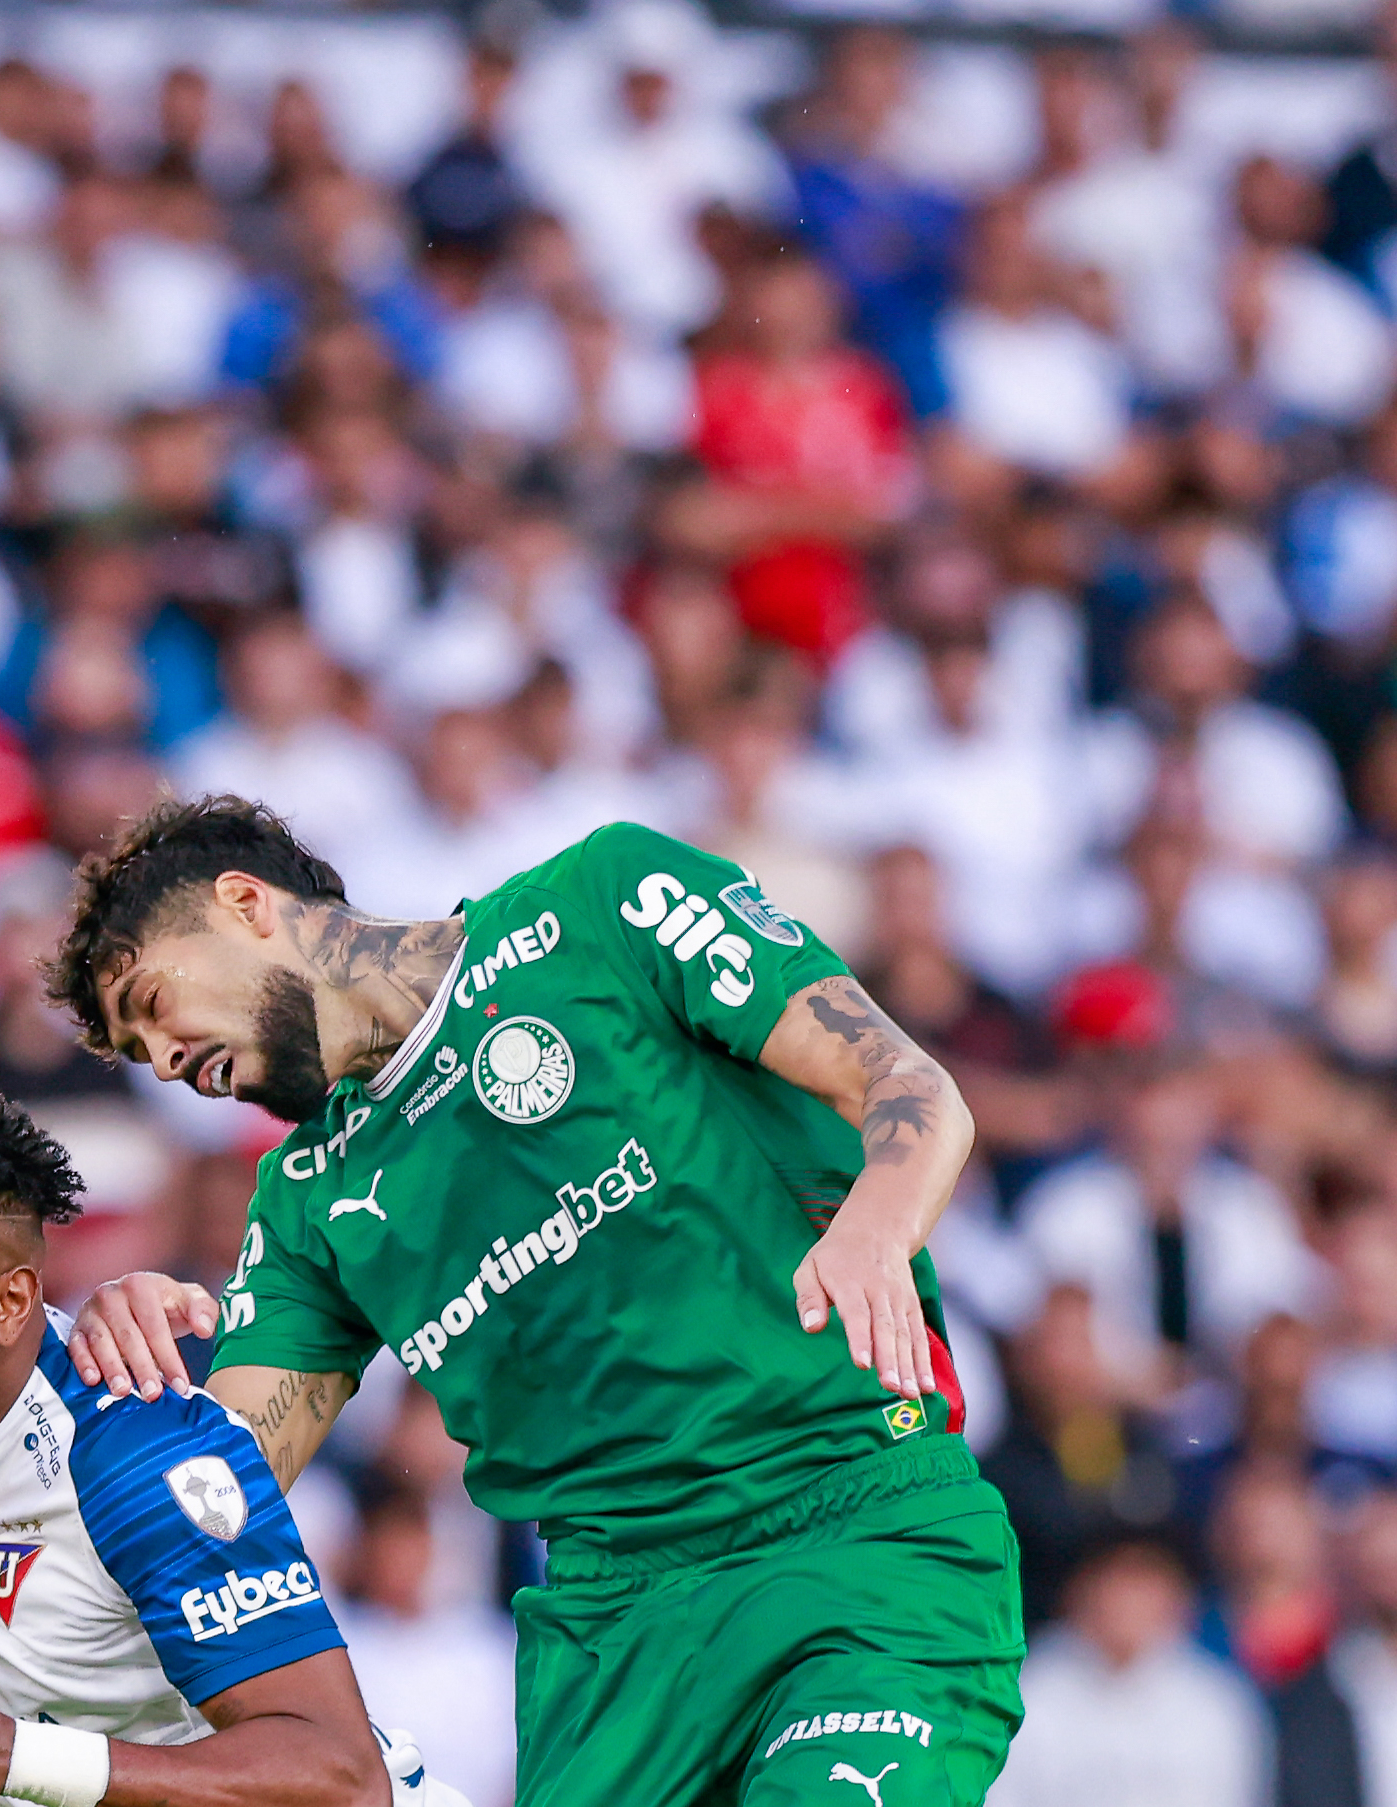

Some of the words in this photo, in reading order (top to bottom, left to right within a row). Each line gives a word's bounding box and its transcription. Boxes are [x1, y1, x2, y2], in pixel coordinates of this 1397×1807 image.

[454, 911, 561, 1009] CIMED
[406, 1062, 470, 1127] Embracon
[485, 1042, 569, 1118] PALMEIRAS
[400, 1137, 657, 1376] sportingbet
[765, 1709, 933, 1759] UNIASSELVI
